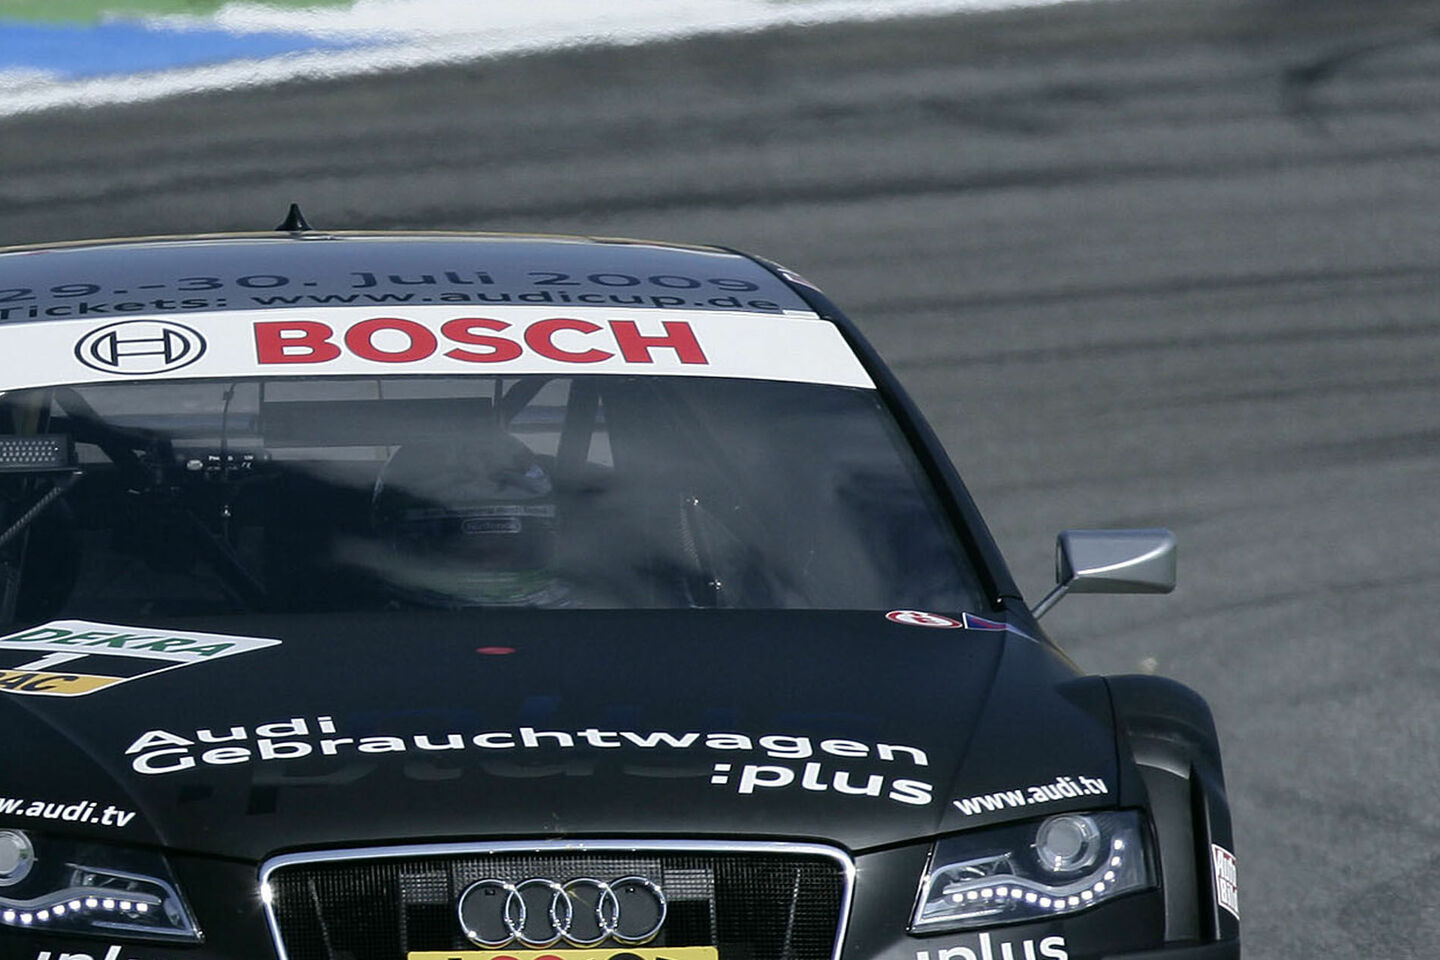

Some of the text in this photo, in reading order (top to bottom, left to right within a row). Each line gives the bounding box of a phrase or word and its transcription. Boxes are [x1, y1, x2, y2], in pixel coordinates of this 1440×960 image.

[250, 289, 780, 311] www.audicup.de
[351, 271, 495, 289] Juli
[527, 271, 760, 293] 2009
[252, 316, 710, 366] BOSCH
[4, 627, 237, 657] DEKRA
[13, 652, 90, 671] 1
[124, 716, 337, 755] Audi
[131, 726, 929, 775] Gebrauchtwagen
[710, 761, 934, 806] :plus
[953, 776, 1108, 816] www.audi.tv
